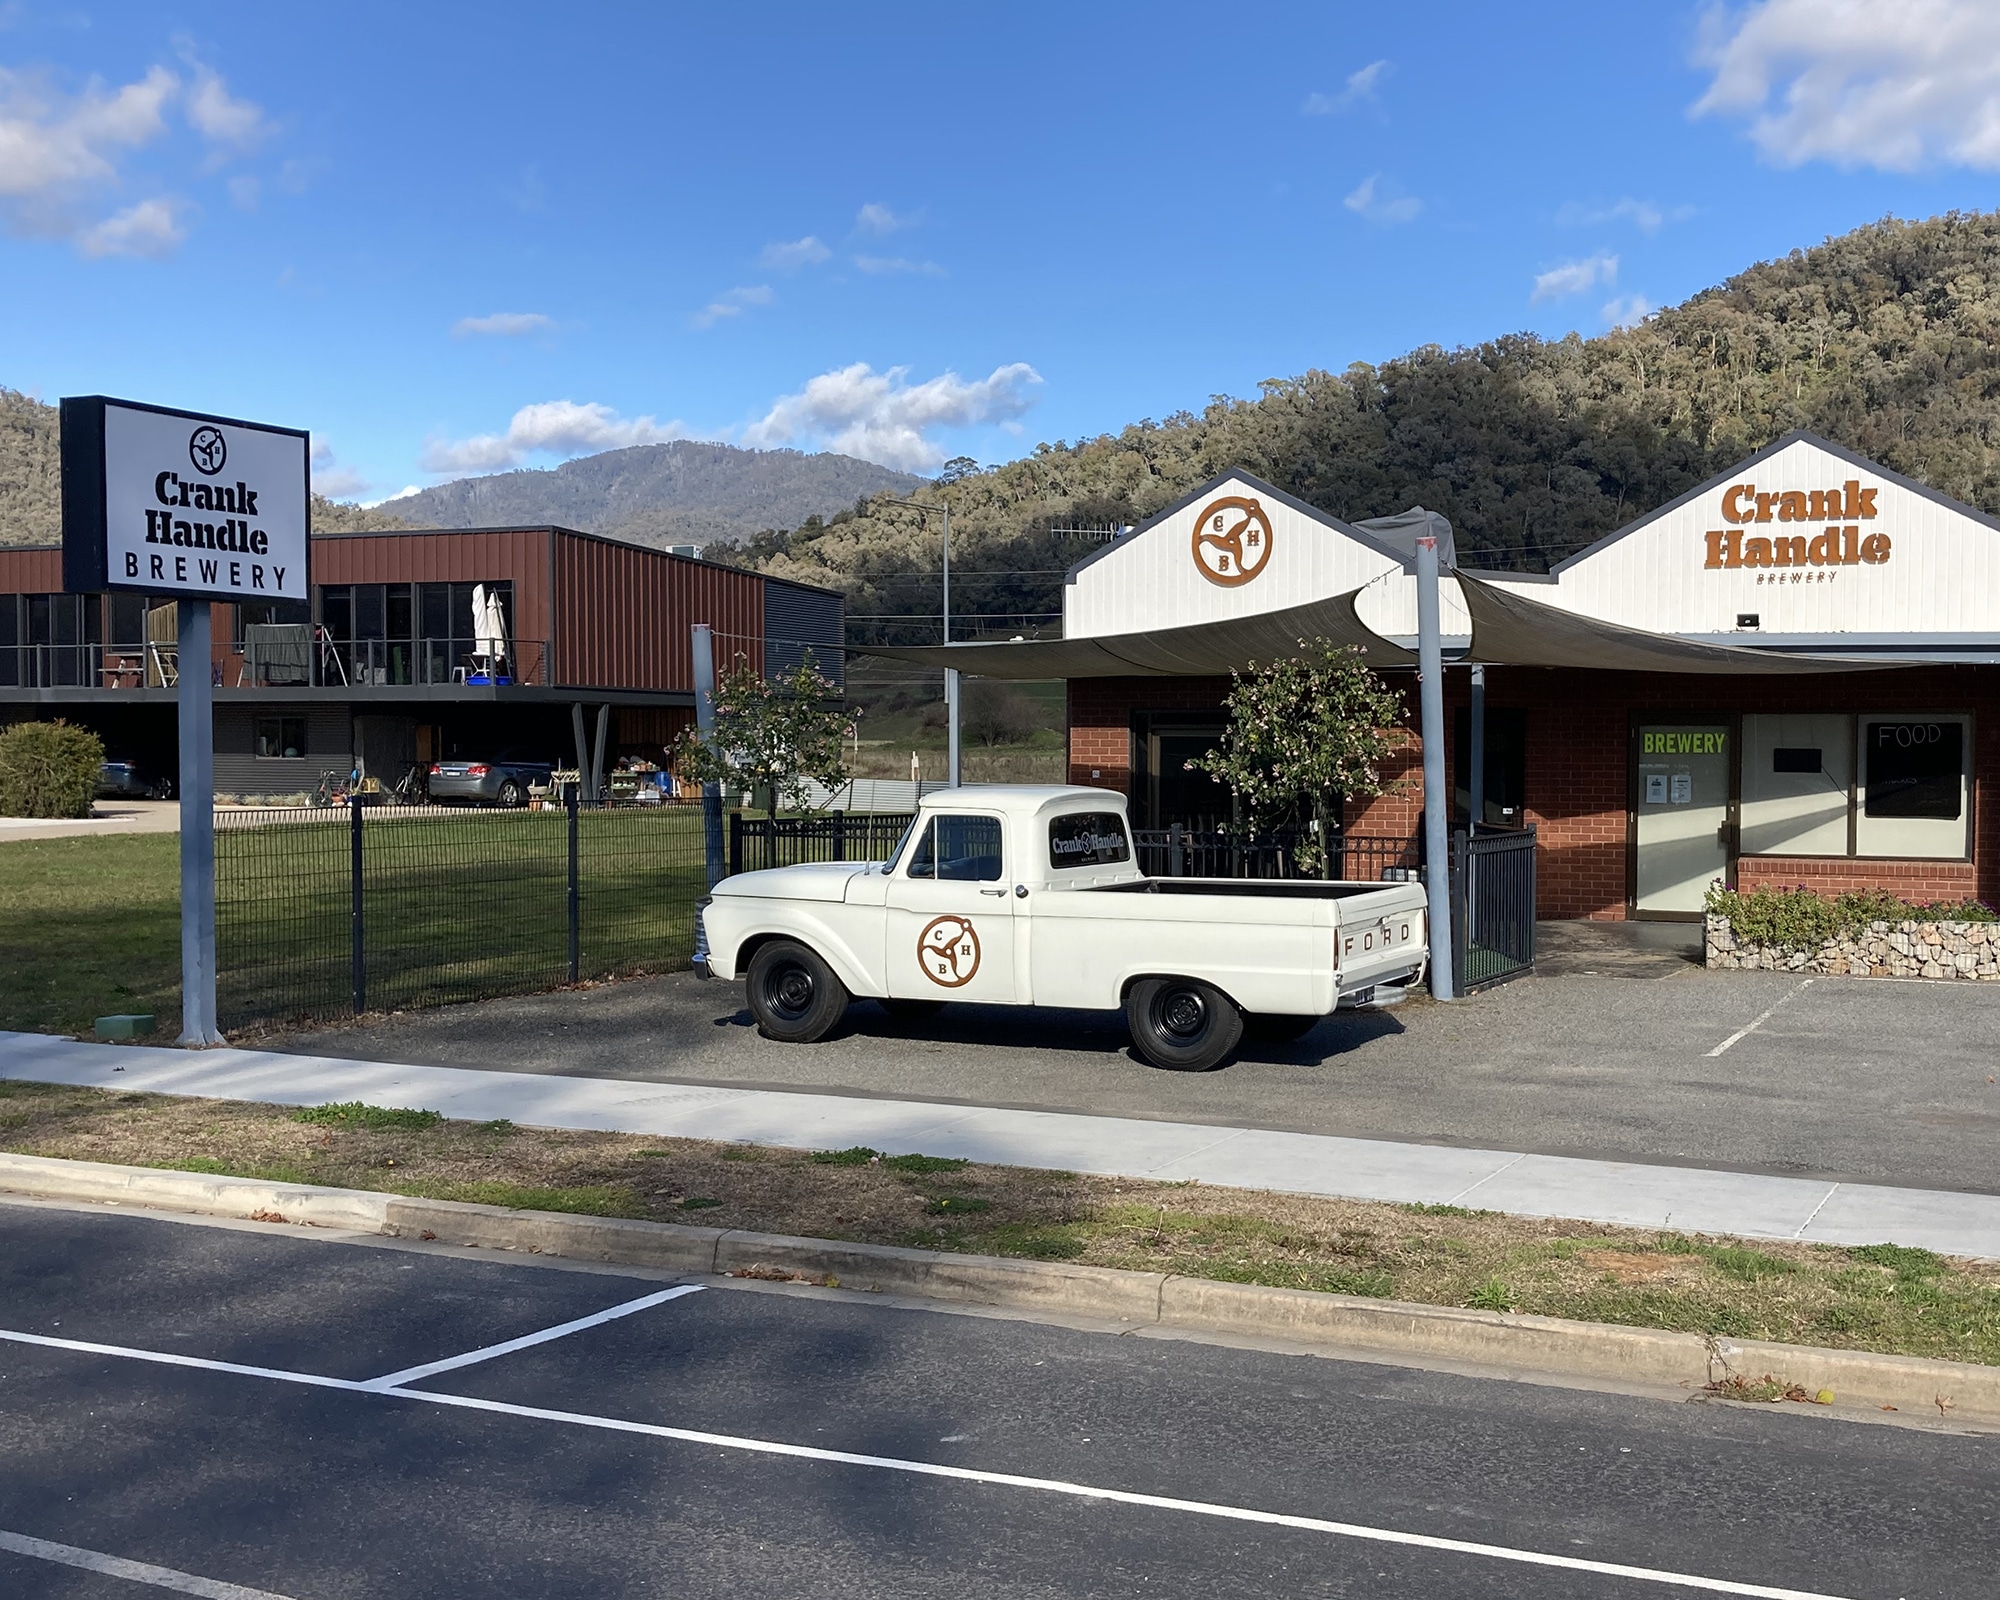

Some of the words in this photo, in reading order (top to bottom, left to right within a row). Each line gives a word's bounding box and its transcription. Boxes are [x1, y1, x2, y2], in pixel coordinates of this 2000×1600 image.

[200, 434, 206, 443] C
[214, 446, 221, 455] H
[202, 457, 208, 466] B
[155, 471, 258, 516] Crank
[1722, 480, 1878, 524] Crank
[1213, 516, 1223, 531] C
[145, 509, 268, 555] Handle
[1247, 530, 1259, 546] H
[1704, 525, 1891, 570] Handle
[125, 552, 286, 590] BREWERY
[1218, 555, 1229, 571] B
[1756, 571, 1837, 585] BREWERY
[1644, 733, 1725, 753] BREWERY
[1879, 724, 1941, 748] FOOD
[1053, 836, 1082, 853] Crank
[1091, 833, 1123, 849] Handle
[934, 930, 942, 941] C
[1345, 924, 1409, 956] FORD
[961, 945, 971, 955] H
[938, 964, 947, 974] B
